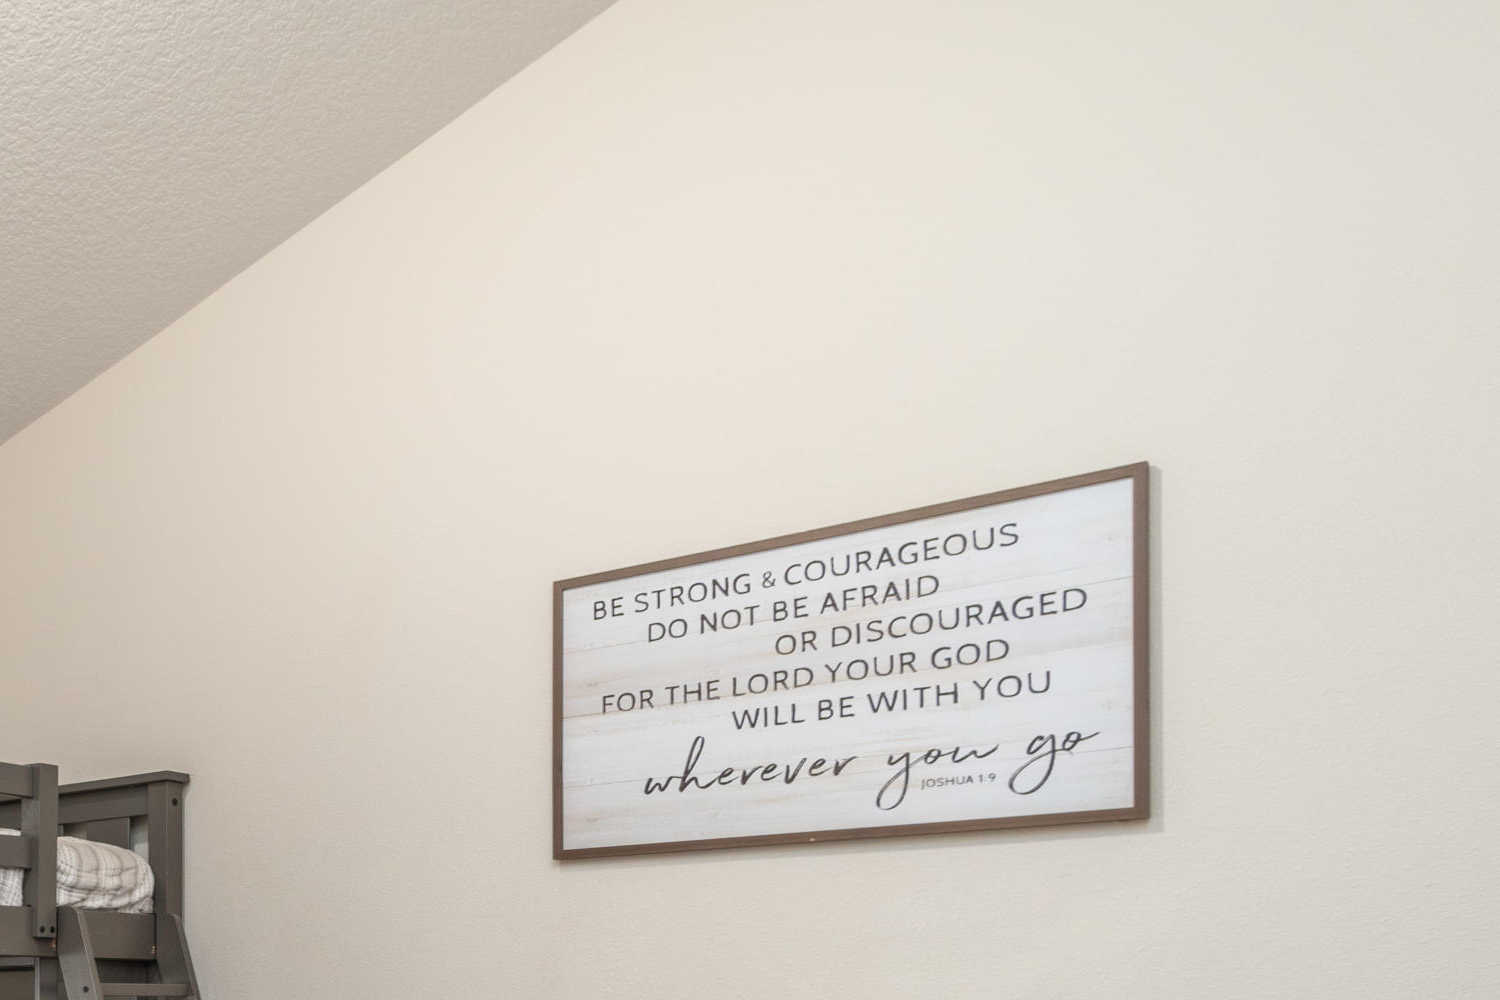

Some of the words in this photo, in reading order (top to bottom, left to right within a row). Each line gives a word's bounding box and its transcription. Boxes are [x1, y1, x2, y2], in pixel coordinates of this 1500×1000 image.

[594, 597, 624, 621] BE
[635, 573, 751, 614] STRONG
[762, 571, 777, 589] &
[784, 523, 1020, 585] COURAGEOUS
[648, 619, 688, 643] DO
[700, 605, 760, 634] NOT
[773, 596, 809, 622] BE
[820, 575, 940, 615] AFRAID
[775, 630, 817, 656] OR
[831, 588, 1088, 648] DISCOURAGED
[602, 689, 655, 715] FOR
[665, 680, 721, 705] THE
[732, 667, 814, 698] LORD
[824, 651, 918, 684] YOUR
[931, 639, 1010, 670] GOD
[732, 703, 805, 730] WILL
[818, 696, 855, 721] BE
[866, 682, 959, 714] WITH
[972, 671, 1051, 702] YOU
[643, 735, 858, 796] wherever
[876, 743, 999, 811] you
[1008, 729, 1100, 796] go
[921, 776, 974, 790] JOSHUA
